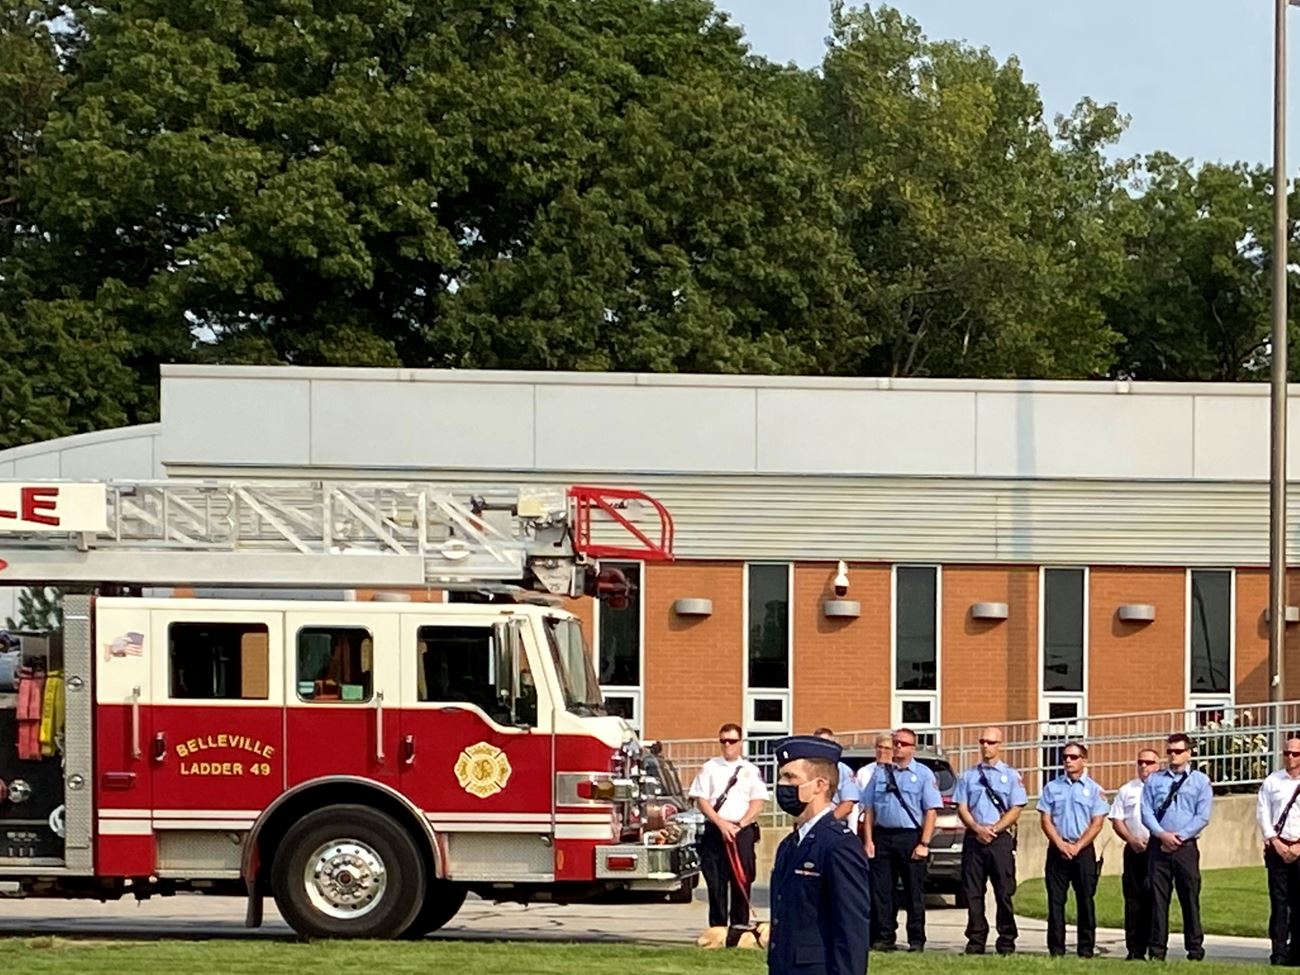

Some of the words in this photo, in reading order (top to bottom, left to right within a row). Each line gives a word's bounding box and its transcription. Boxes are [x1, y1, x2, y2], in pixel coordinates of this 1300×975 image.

[176, 734, 275, 759] BELLEVILLE
[180, 762, 243, 775] LADDER
[249, 762, 271, 776] 49
